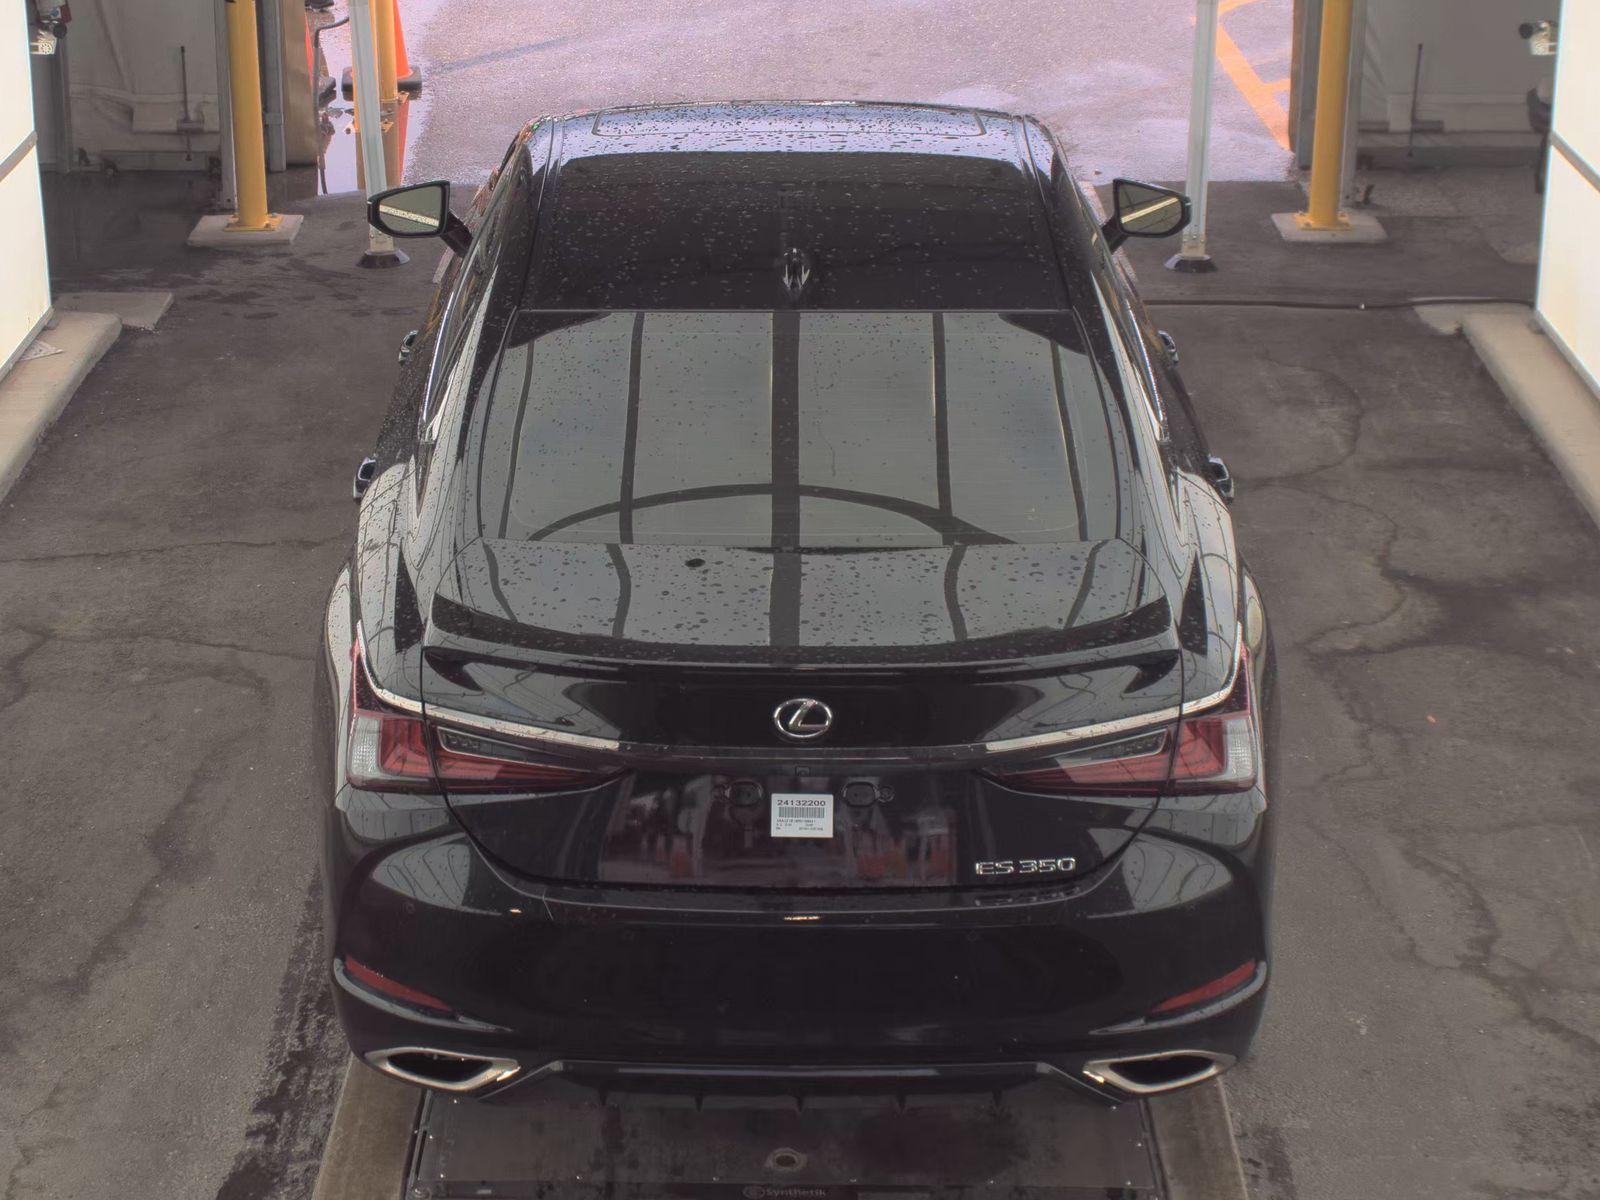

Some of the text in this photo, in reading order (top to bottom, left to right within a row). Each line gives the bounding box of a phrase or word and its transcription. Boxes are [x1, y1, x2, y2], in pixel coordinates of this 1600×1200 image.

[777, 799, 826, 807] 24132200
[975, 857, 1076, 875] ES 350
